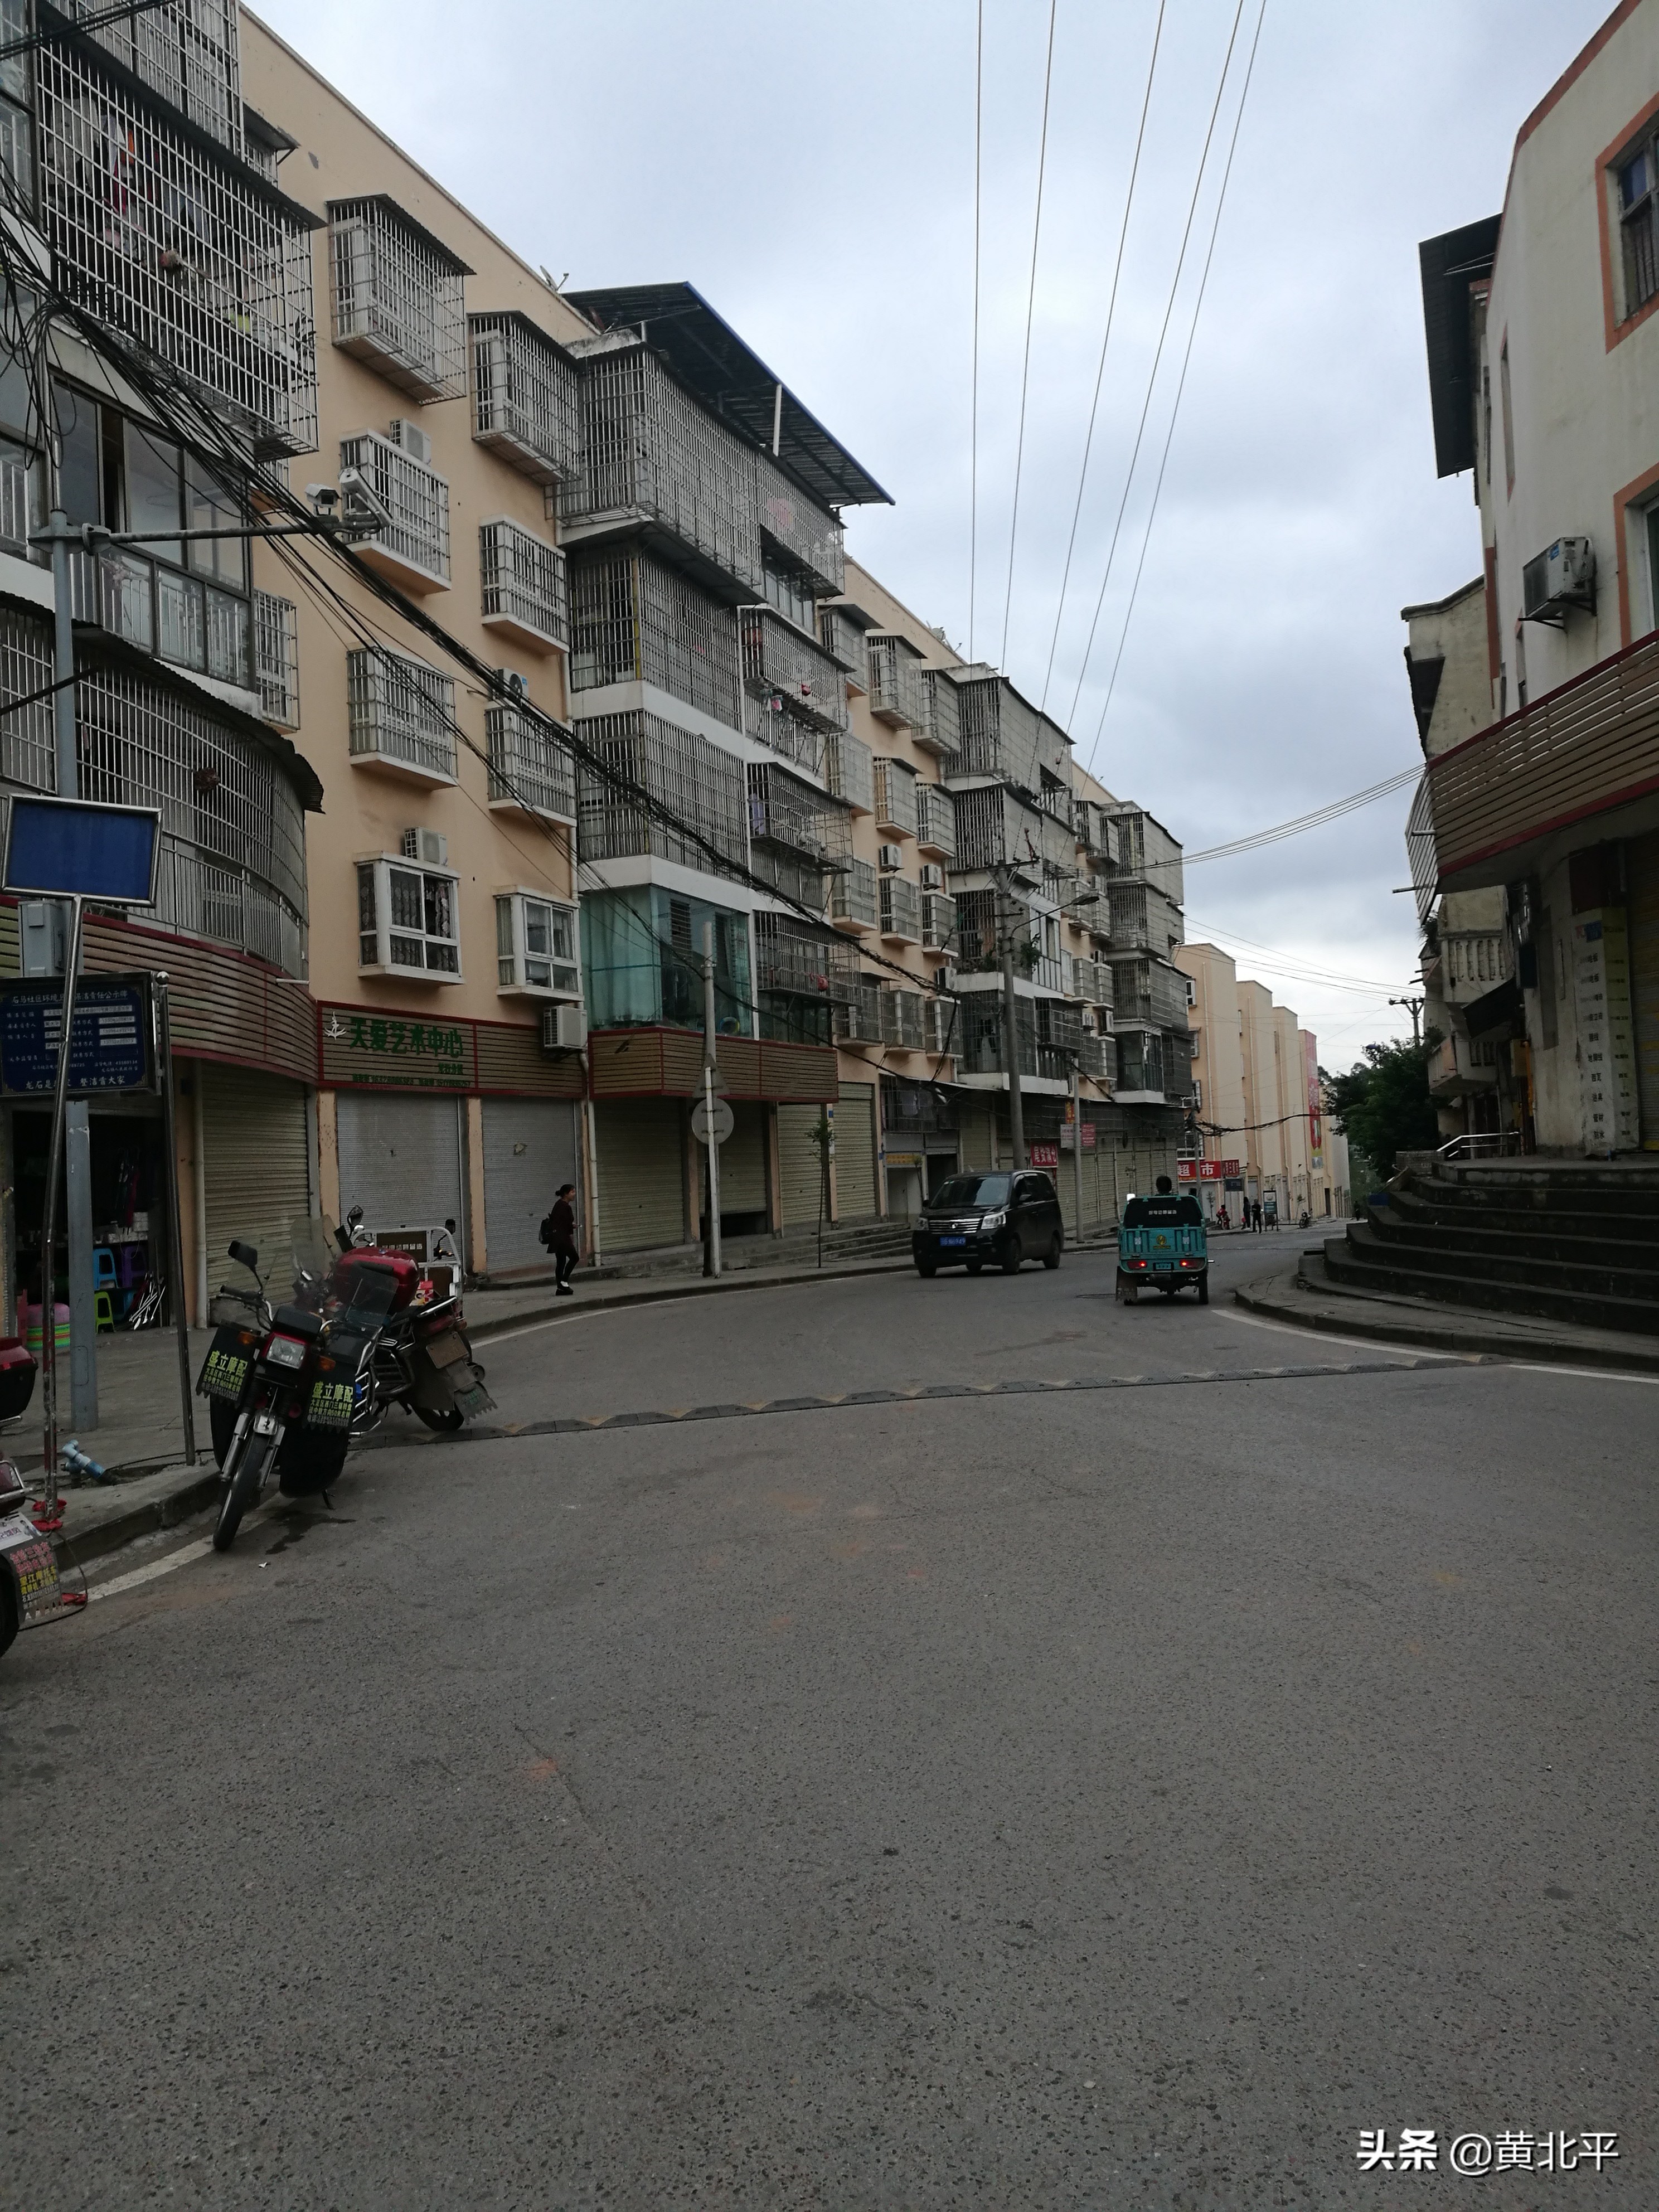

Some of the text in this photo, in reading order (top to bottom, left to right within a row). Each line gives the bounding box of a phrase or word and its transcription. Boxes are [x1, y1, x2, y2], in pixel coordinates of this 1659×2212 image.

[350, 1017, 464, 1058] 天爱艺术中心
[207, 1350, 249, 1377] 盛立摩配
[312, 1380, 354, 1403] 盛立摩配
